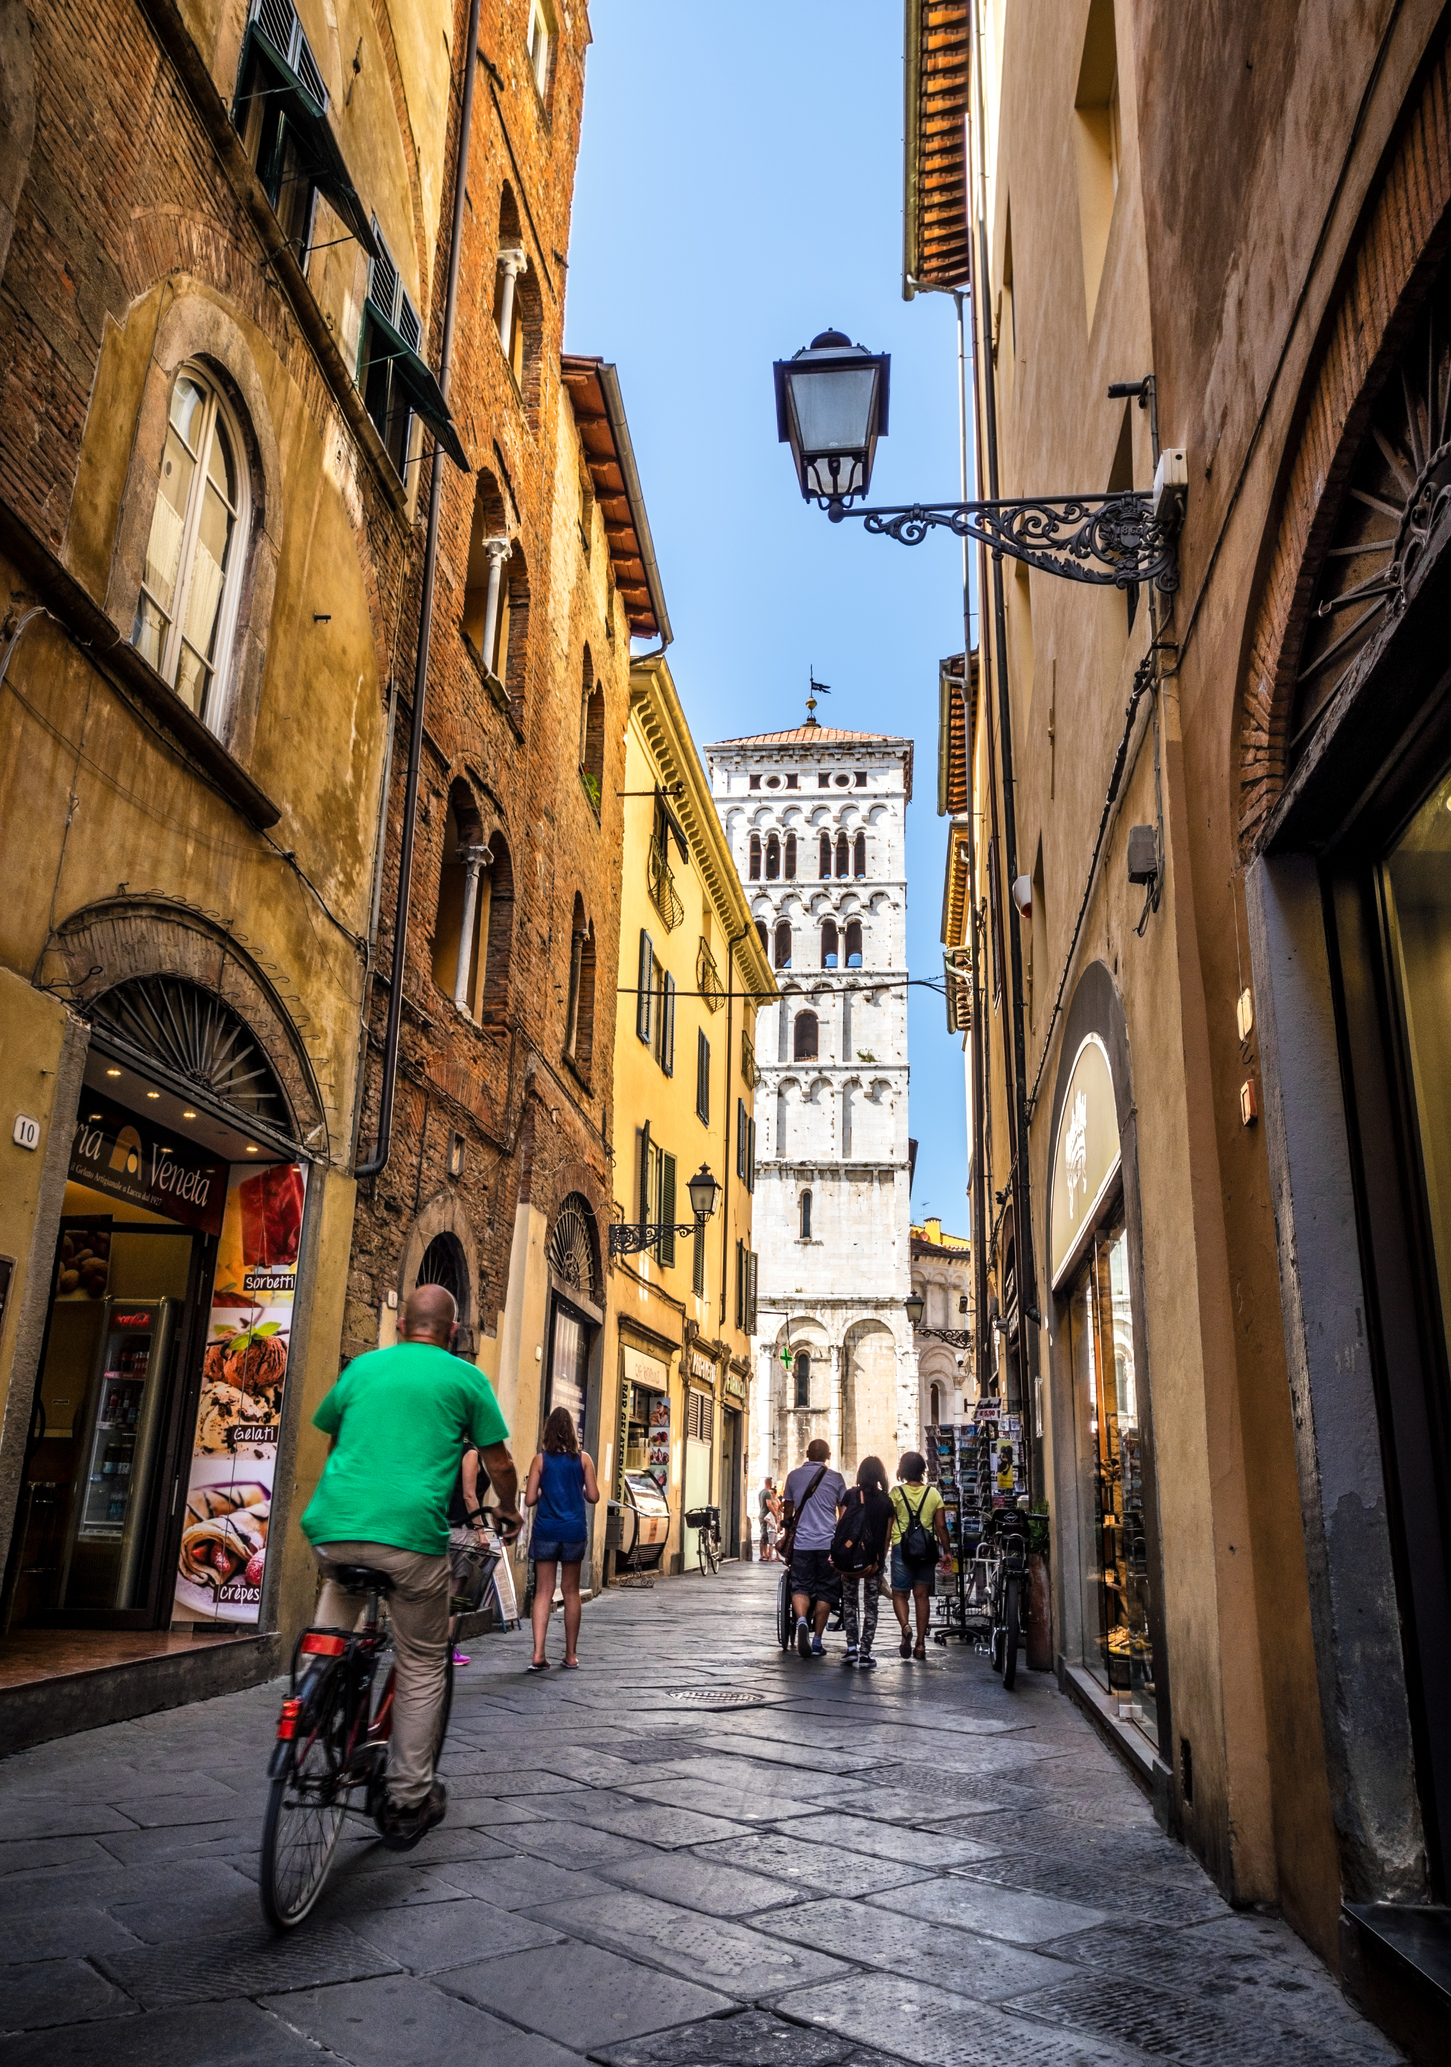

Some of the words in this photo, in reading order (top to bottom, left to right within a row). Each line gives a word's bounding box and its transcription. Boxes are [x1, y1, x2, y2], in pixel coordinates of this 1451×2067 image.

[20, 1121, 35, 1143] 10
[75, 1164, 95, 1179] Gelato
[93, 1172, 122, 1191] Artigianale
[127, 1185, 142, 1199] Lucca
[141, 1192, 150, 1203] dal
[151, 1142, 211, 1208] Veneta
[245, 1275, 294, 1289] Sorbetti
[233, 1426, 274, 1441] Gelati
